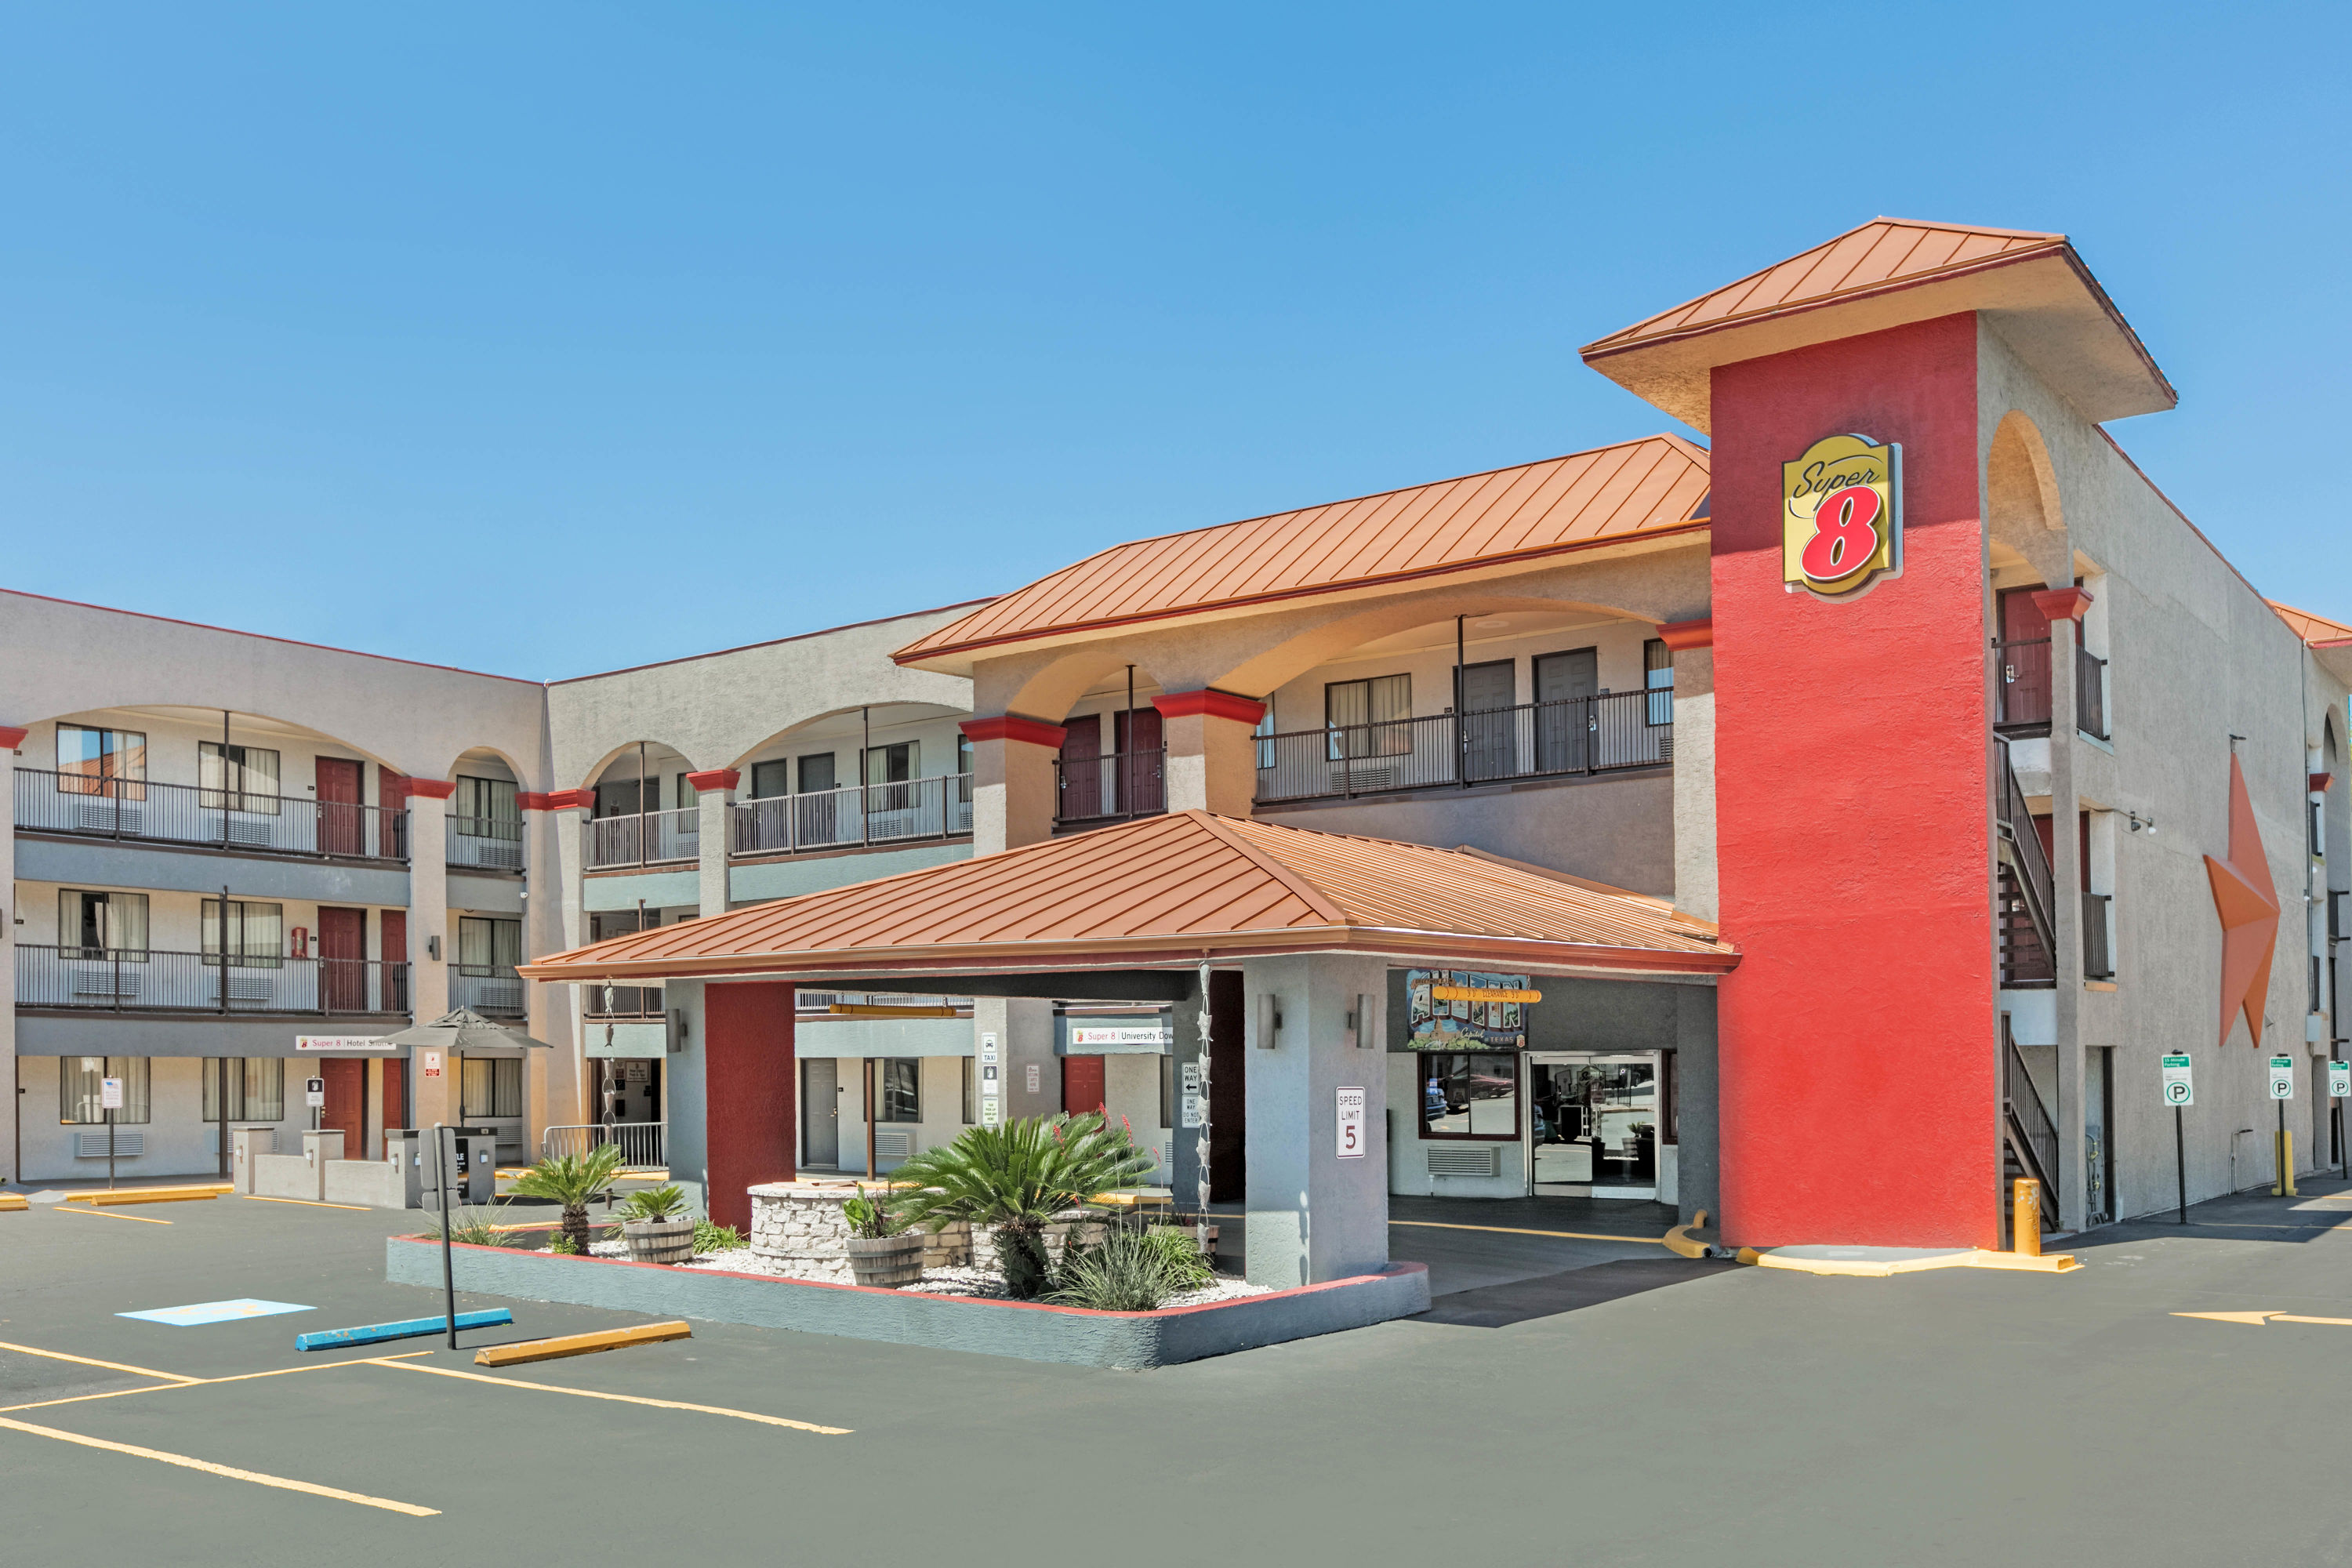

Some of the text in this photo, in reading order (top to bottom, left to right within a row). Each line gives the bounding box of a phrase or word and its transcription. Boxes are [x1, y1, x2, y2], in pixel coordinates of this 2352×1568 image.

[1790, 458, 1881, 514] Super
[1800, 485, 1883, 581] 8
[1088, 1032, 1108, 1040] Super
[1121, 1032, 1156, 1041] University
[1461, 1027, 1486, 1040] Capitol
[2174, 1087, 2185, 1098] P
[2278, 1083, 2287, 1094] P
[2337, 1083, 2345, 1091] P
[1339, 1096, 1363, 1105] SPEED
[1341, 1110, 1359, 1120] LIMIT
[1345, 1125, 1356, 1149] 5
